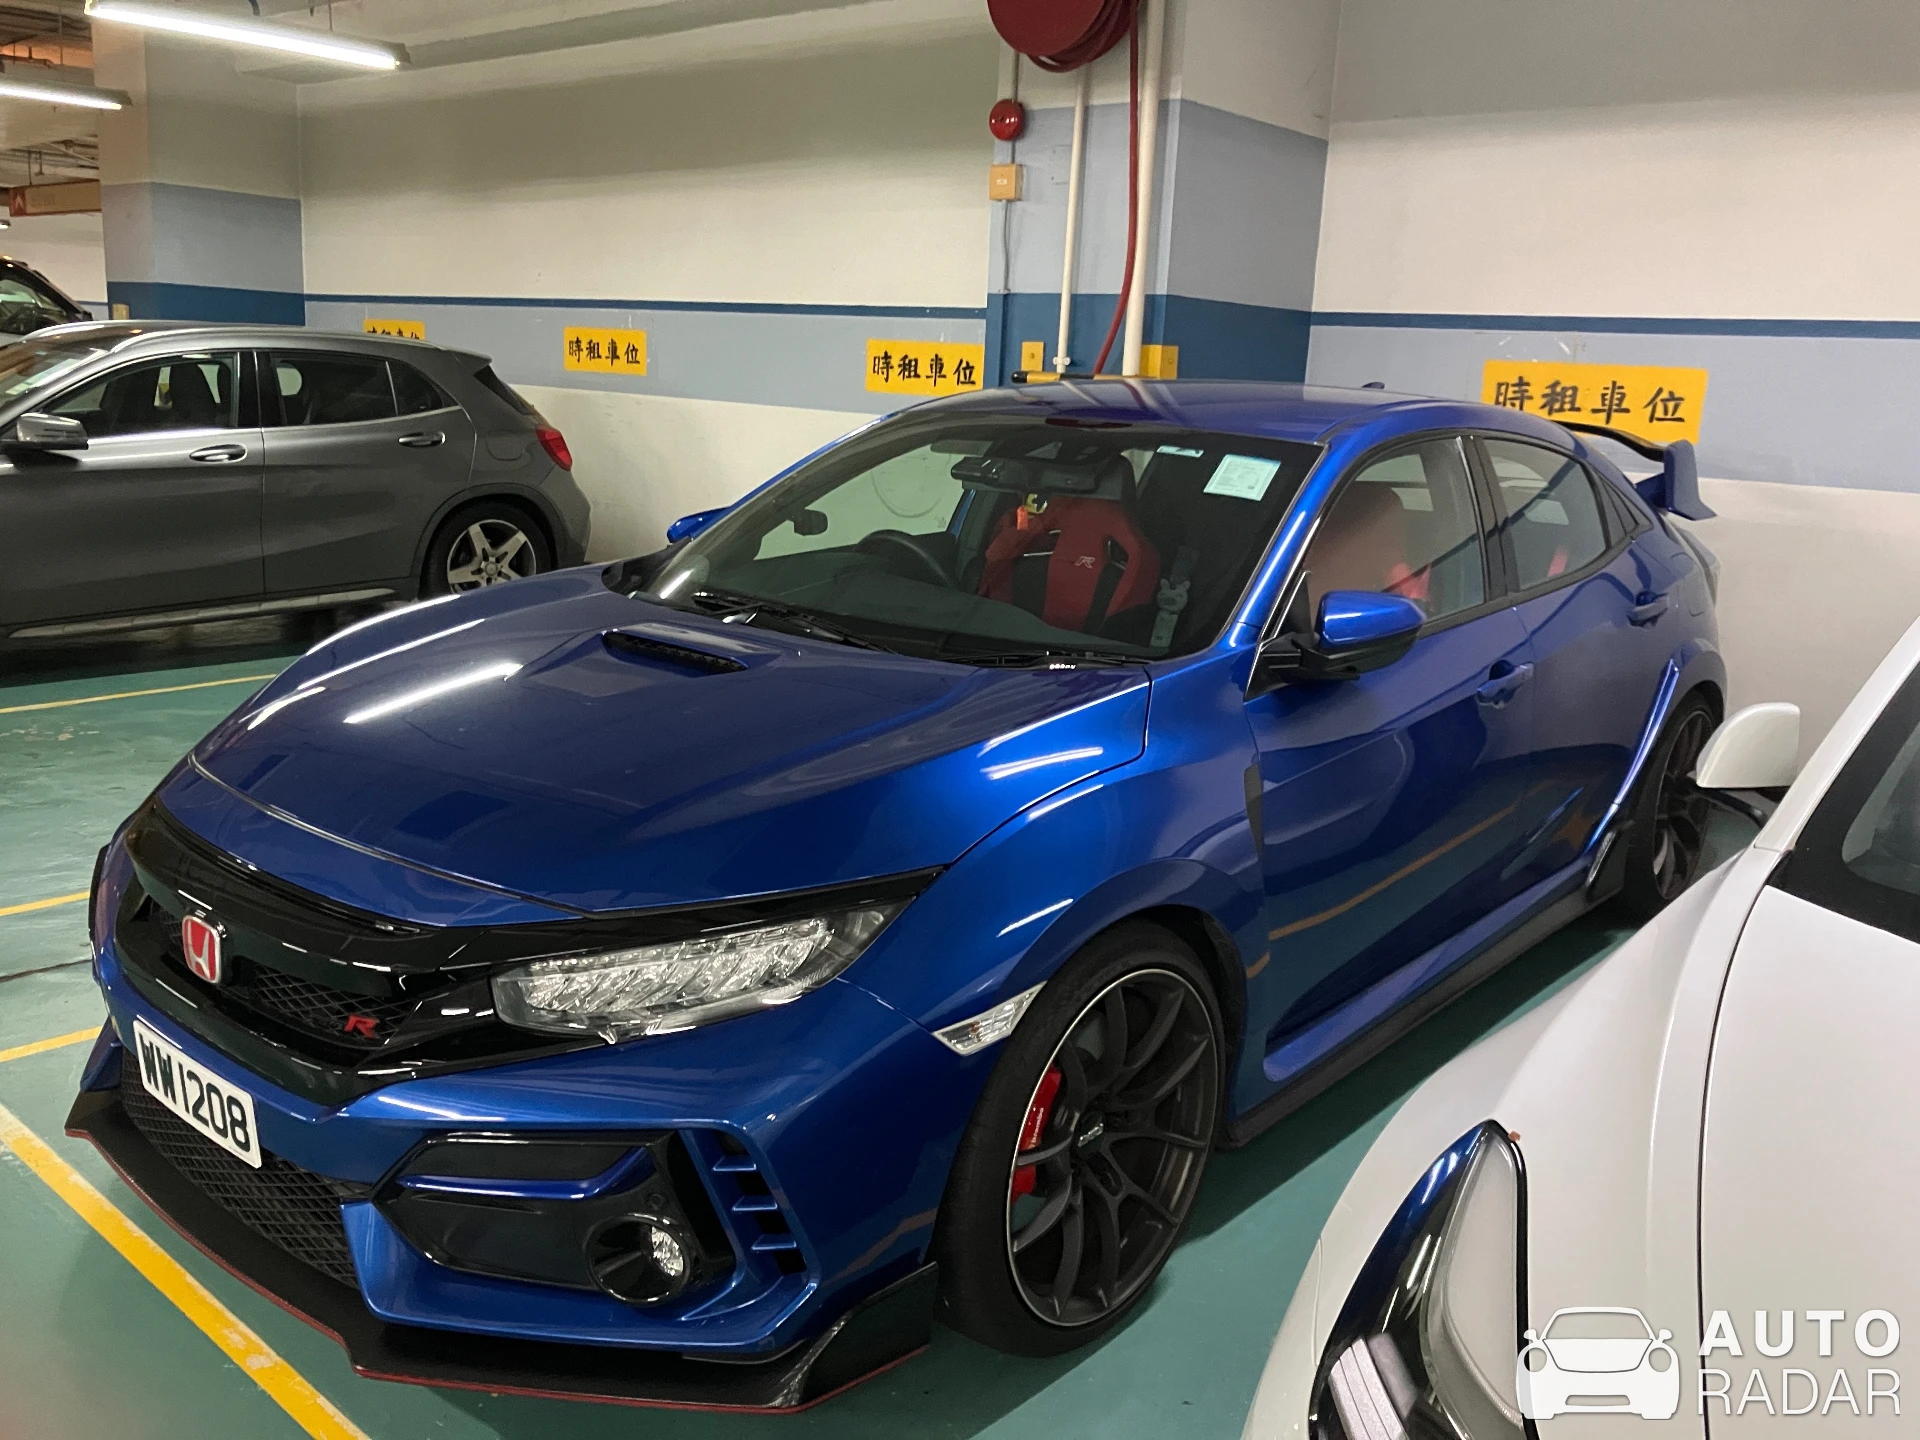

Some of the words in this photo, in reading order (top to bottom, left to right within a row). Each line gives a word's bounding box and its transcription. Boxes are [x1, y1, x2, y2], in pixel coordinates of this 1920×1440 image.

[569, 336, 640, 367] 時租車位
[872, 350, 976, 387] 時租車位
[1494, 375, 1686, 425] 時租車位
